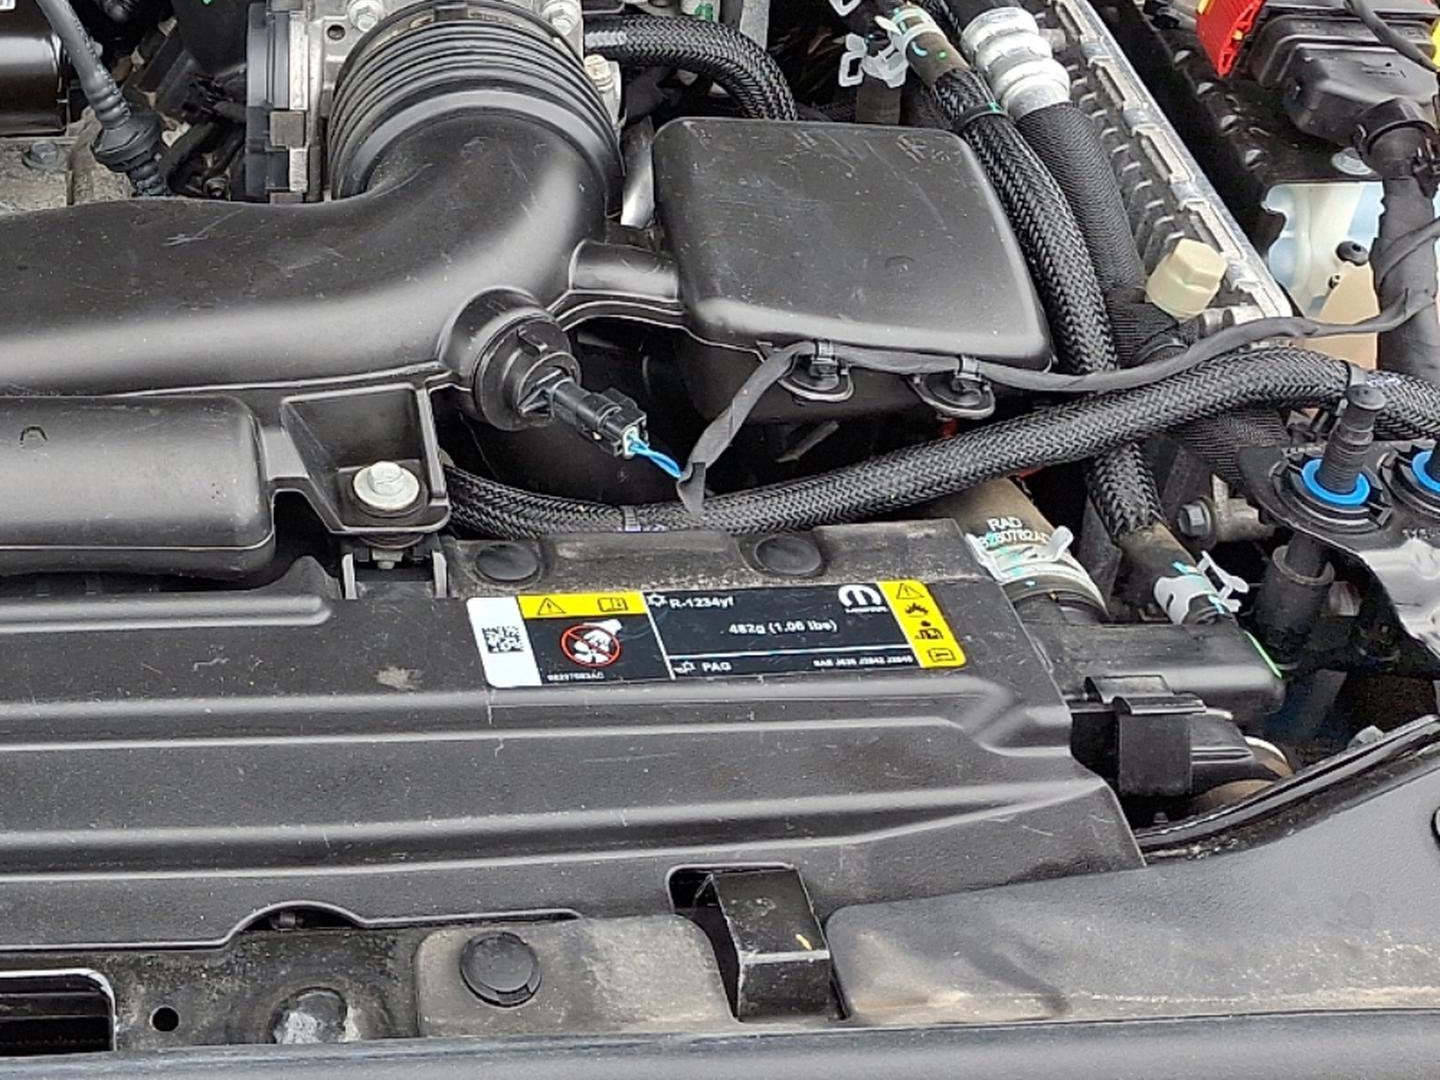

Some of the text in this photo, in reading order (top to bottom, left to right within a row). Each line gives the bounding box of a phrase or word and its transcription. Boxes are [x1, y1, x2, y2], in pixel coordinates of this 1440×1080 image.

[987, 516, 1023, 531] RAD
[669, 595, 735, 609] R-1234yf
[728, 623, 765, 636] 482g
[808, 619, 838, 633] lbs)
[701, 661, 732, 672] PAG
